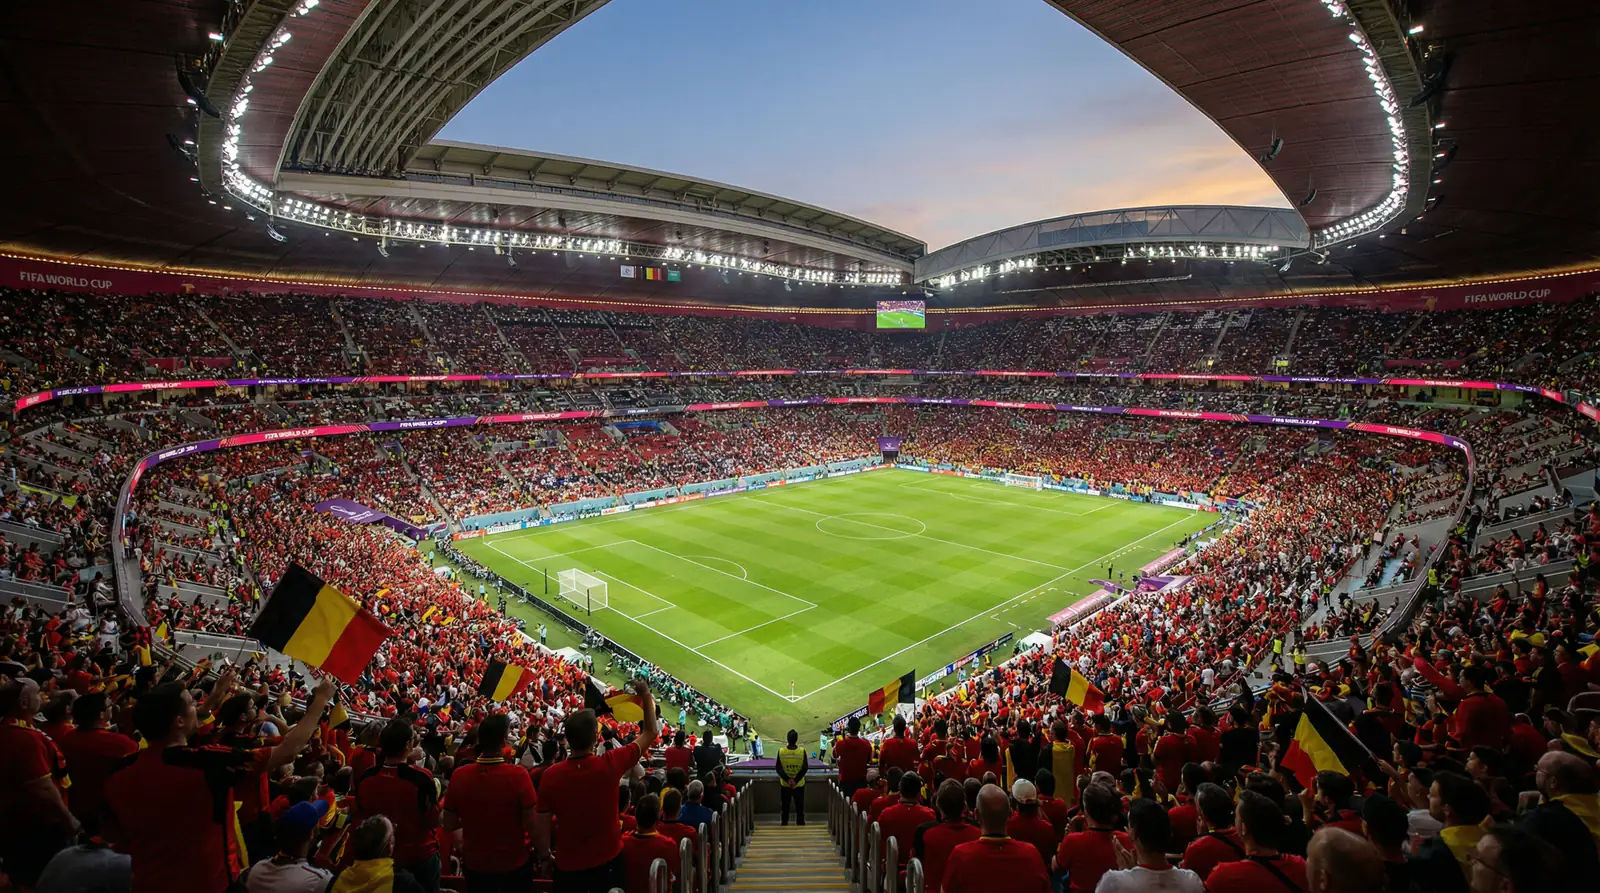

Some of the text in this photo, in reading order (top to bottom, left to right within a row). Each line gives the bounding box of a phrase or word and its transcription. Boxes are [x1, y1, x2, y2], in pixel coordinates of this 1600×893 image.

[20, 271, 112, 289] FIFA WORLD CUP
[1464, 288, 1551, 303] FIFA WORLD CUP
